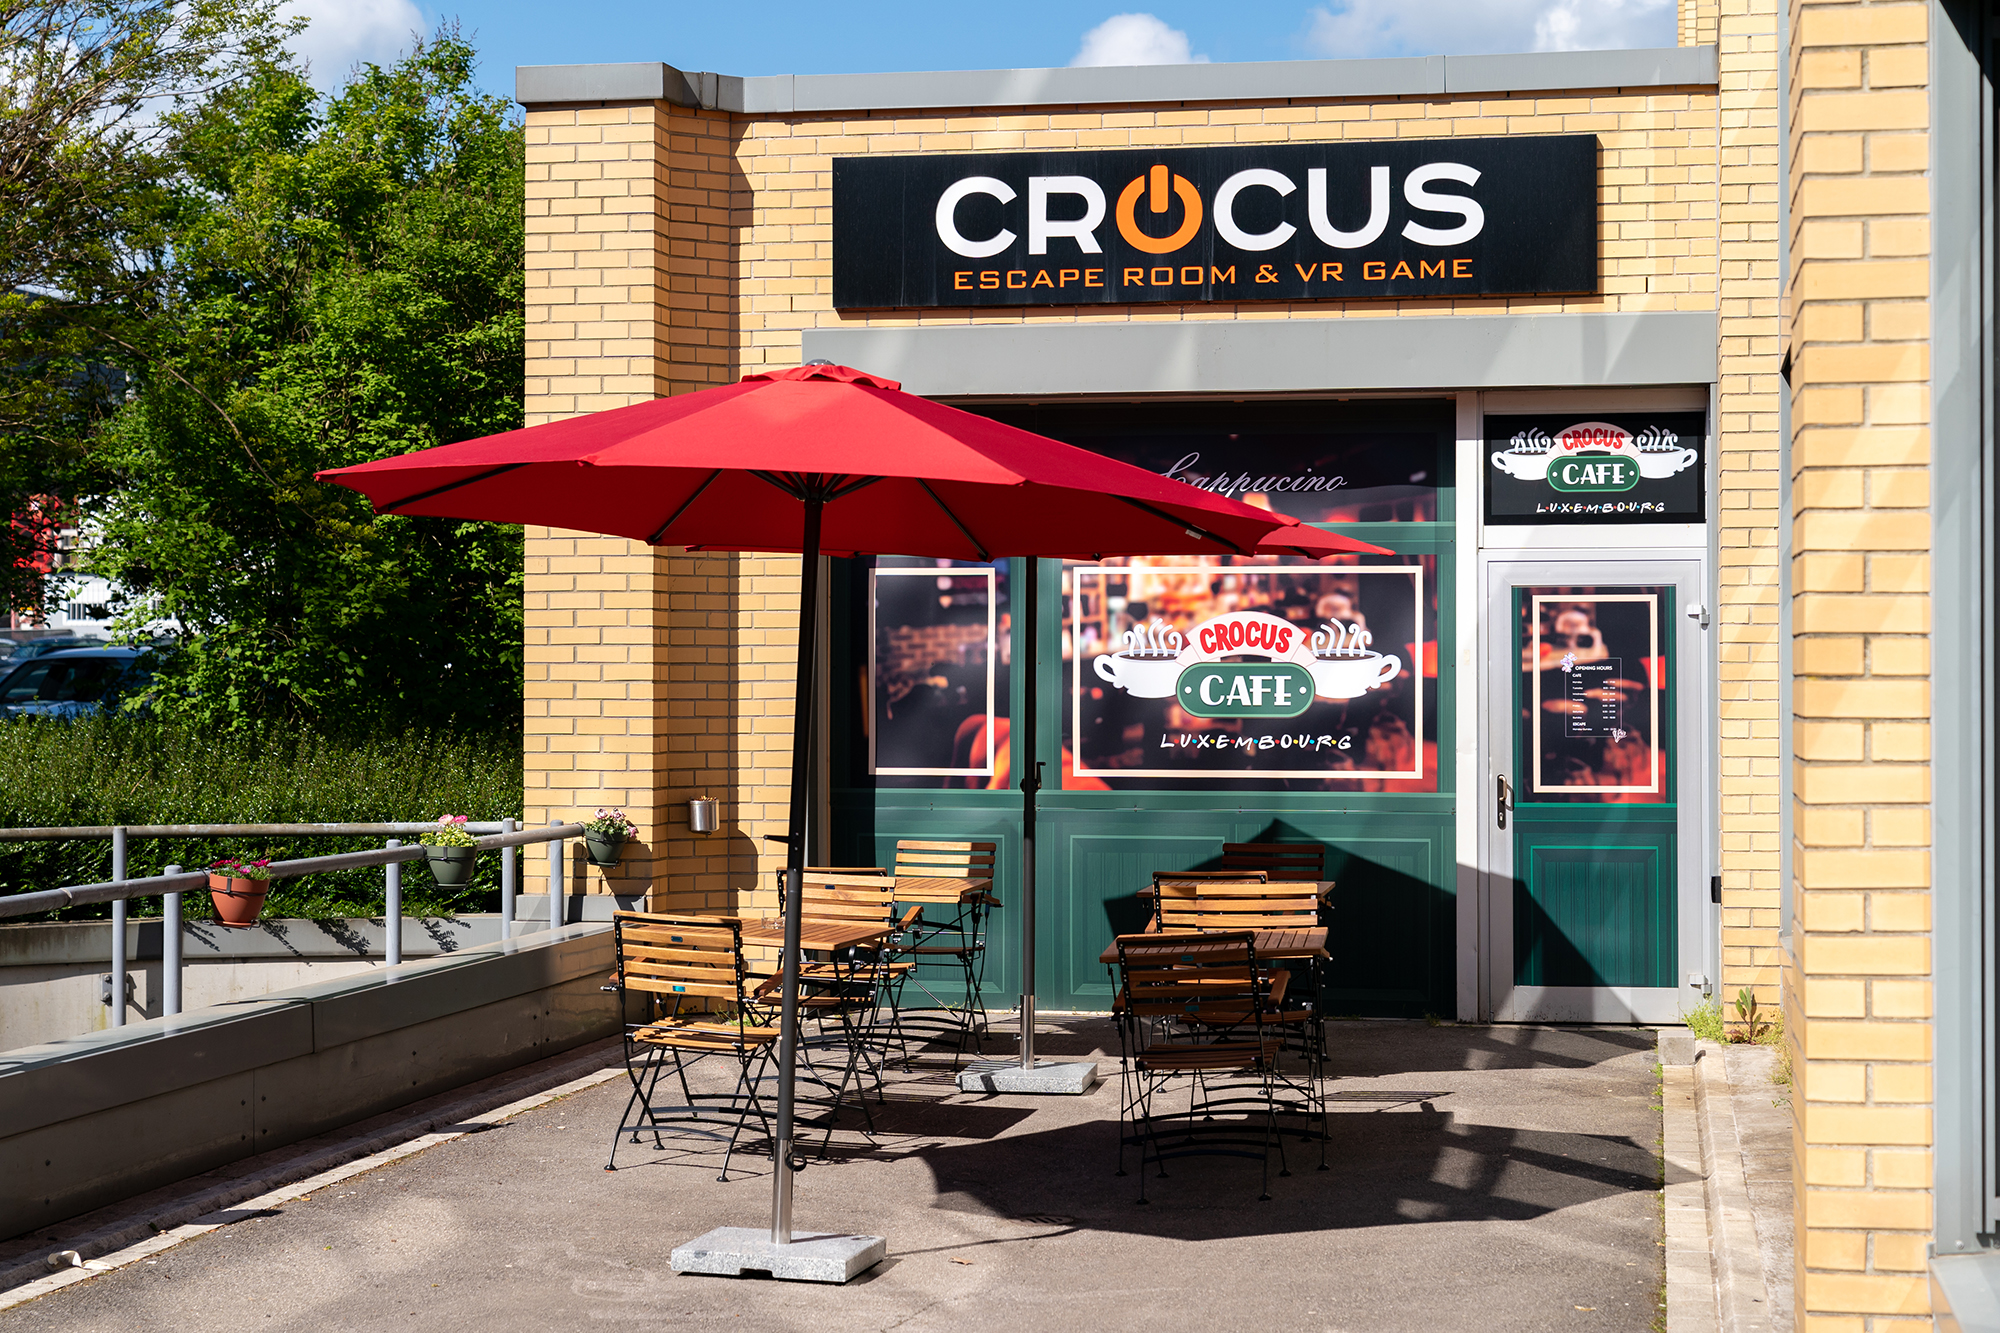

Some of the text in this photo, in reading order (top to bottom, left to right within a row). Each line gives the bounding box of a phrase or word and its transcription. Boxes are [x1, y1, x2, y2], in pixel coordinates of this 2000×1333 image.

[935, 162, 1485, 259] CROCUS
[954, 259, 1474, 291] ESCAPE ROOM & VR GAME
[1562, 428, 1625, 450] CROCUS
[1562, 463, 1625, 485] CAFE
[1199, 621, 1293, 653] CROCUS
[1199, 675, 1292, 706] CAFE
